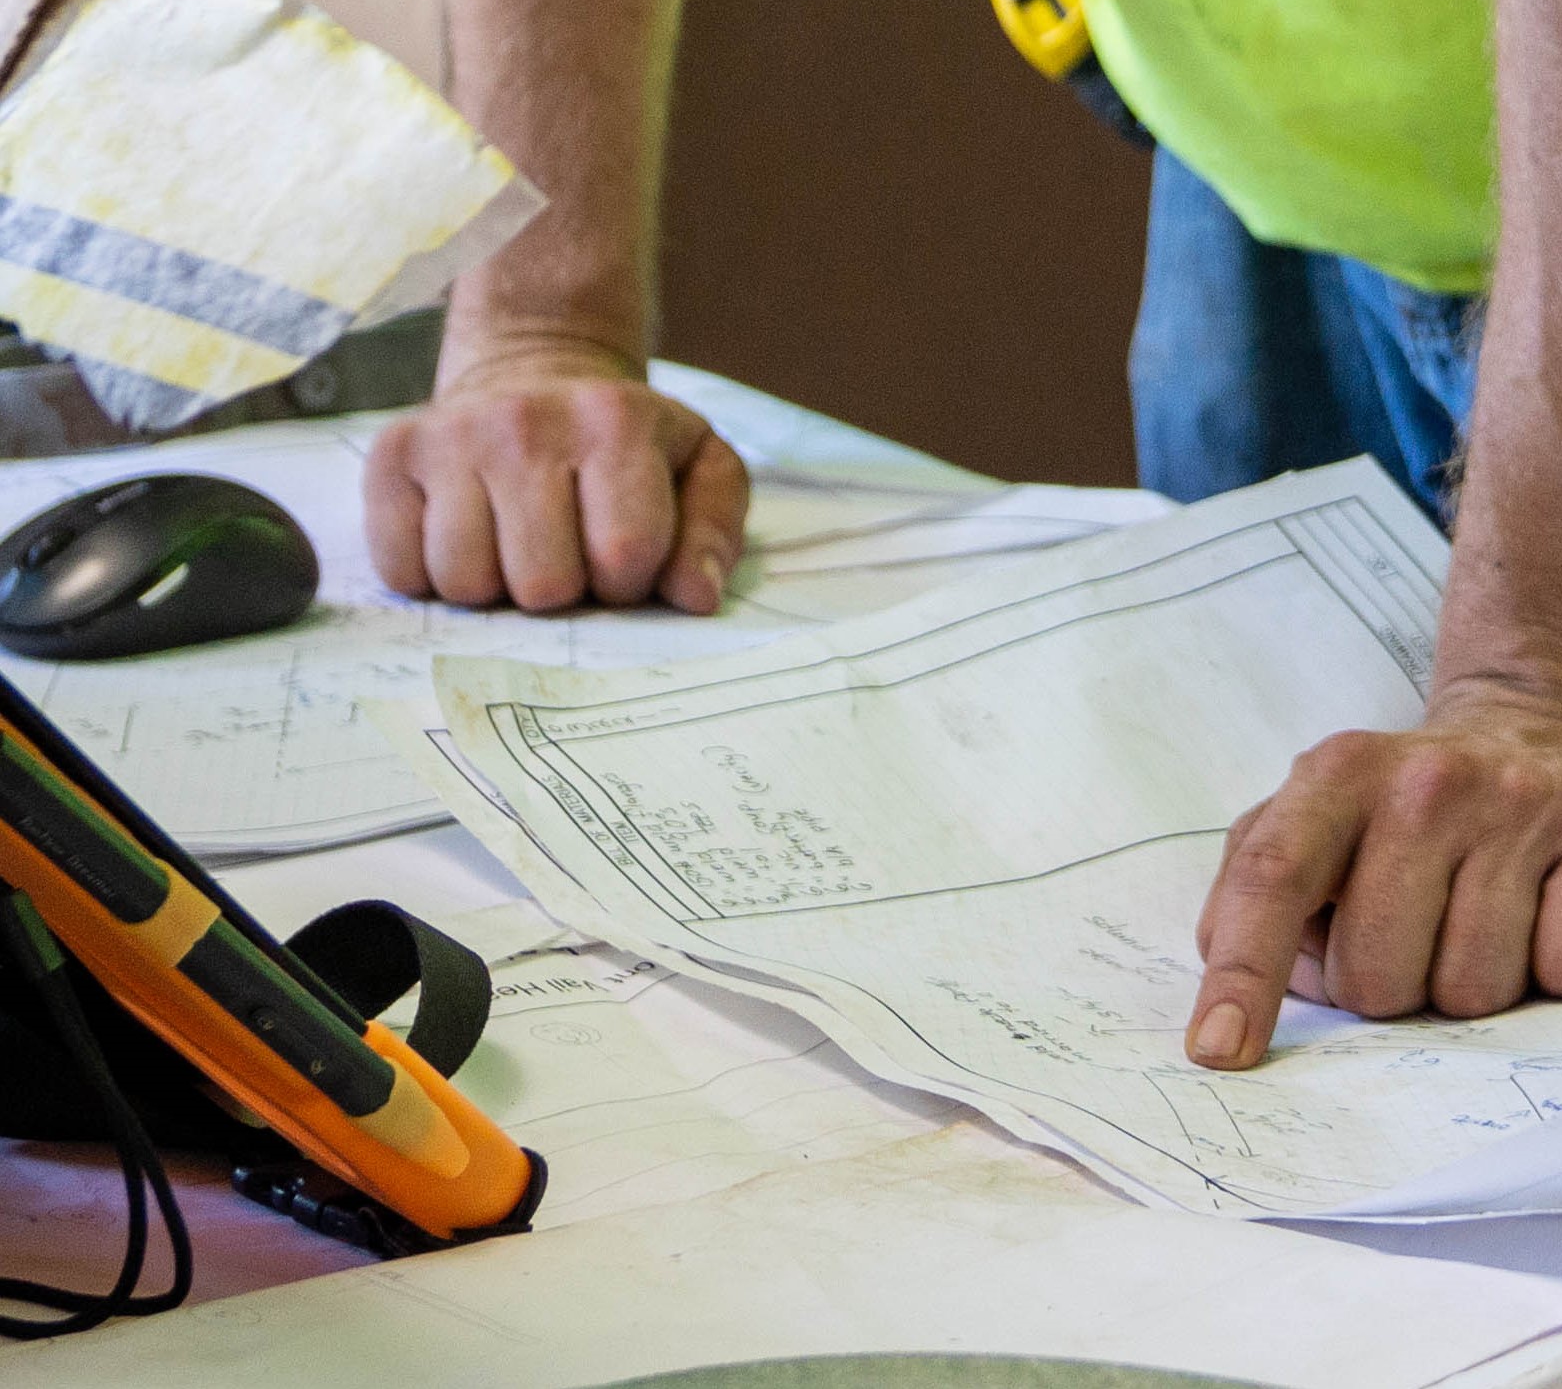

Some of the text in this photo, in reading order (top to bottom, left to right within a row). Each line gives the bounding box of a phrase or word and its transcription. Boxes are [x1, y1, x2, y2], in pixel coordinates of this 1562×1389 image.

[542, 775, 634, 867] BILL OF MATERIALS
[611, 821, 639, 844] ITEM
